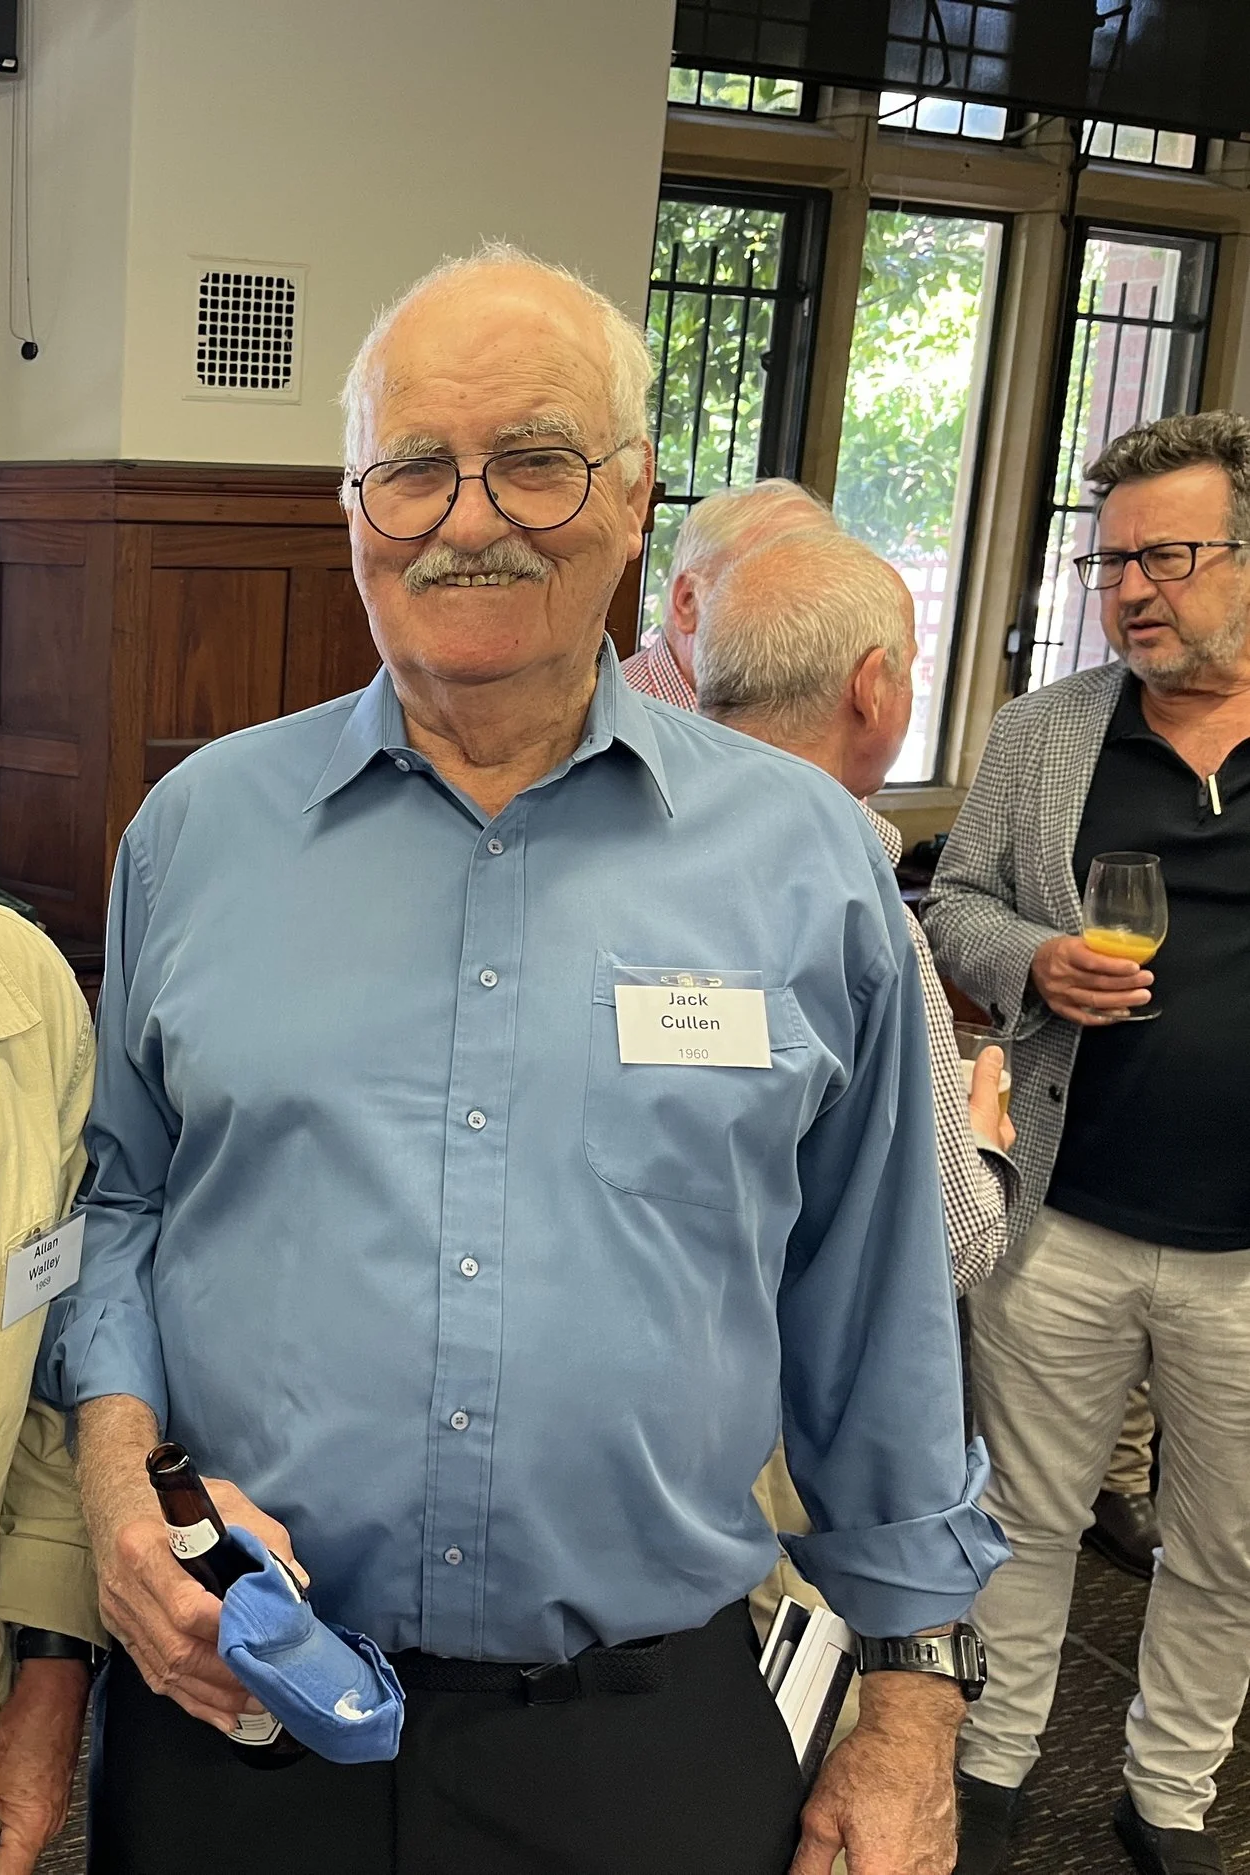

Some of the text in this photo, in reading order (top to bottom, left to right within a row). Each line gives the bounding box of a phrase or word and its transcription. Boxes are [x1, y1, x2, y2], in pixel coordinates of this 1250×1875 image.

[669, 992, 708, 1006] Jack
[661, 1015, 720, 1030] Cullen
[678, 1049, 709, 1059] 1960
[34, 1238, 58, 1259] Allan
[29, 1255, 60, 1281] Walley
